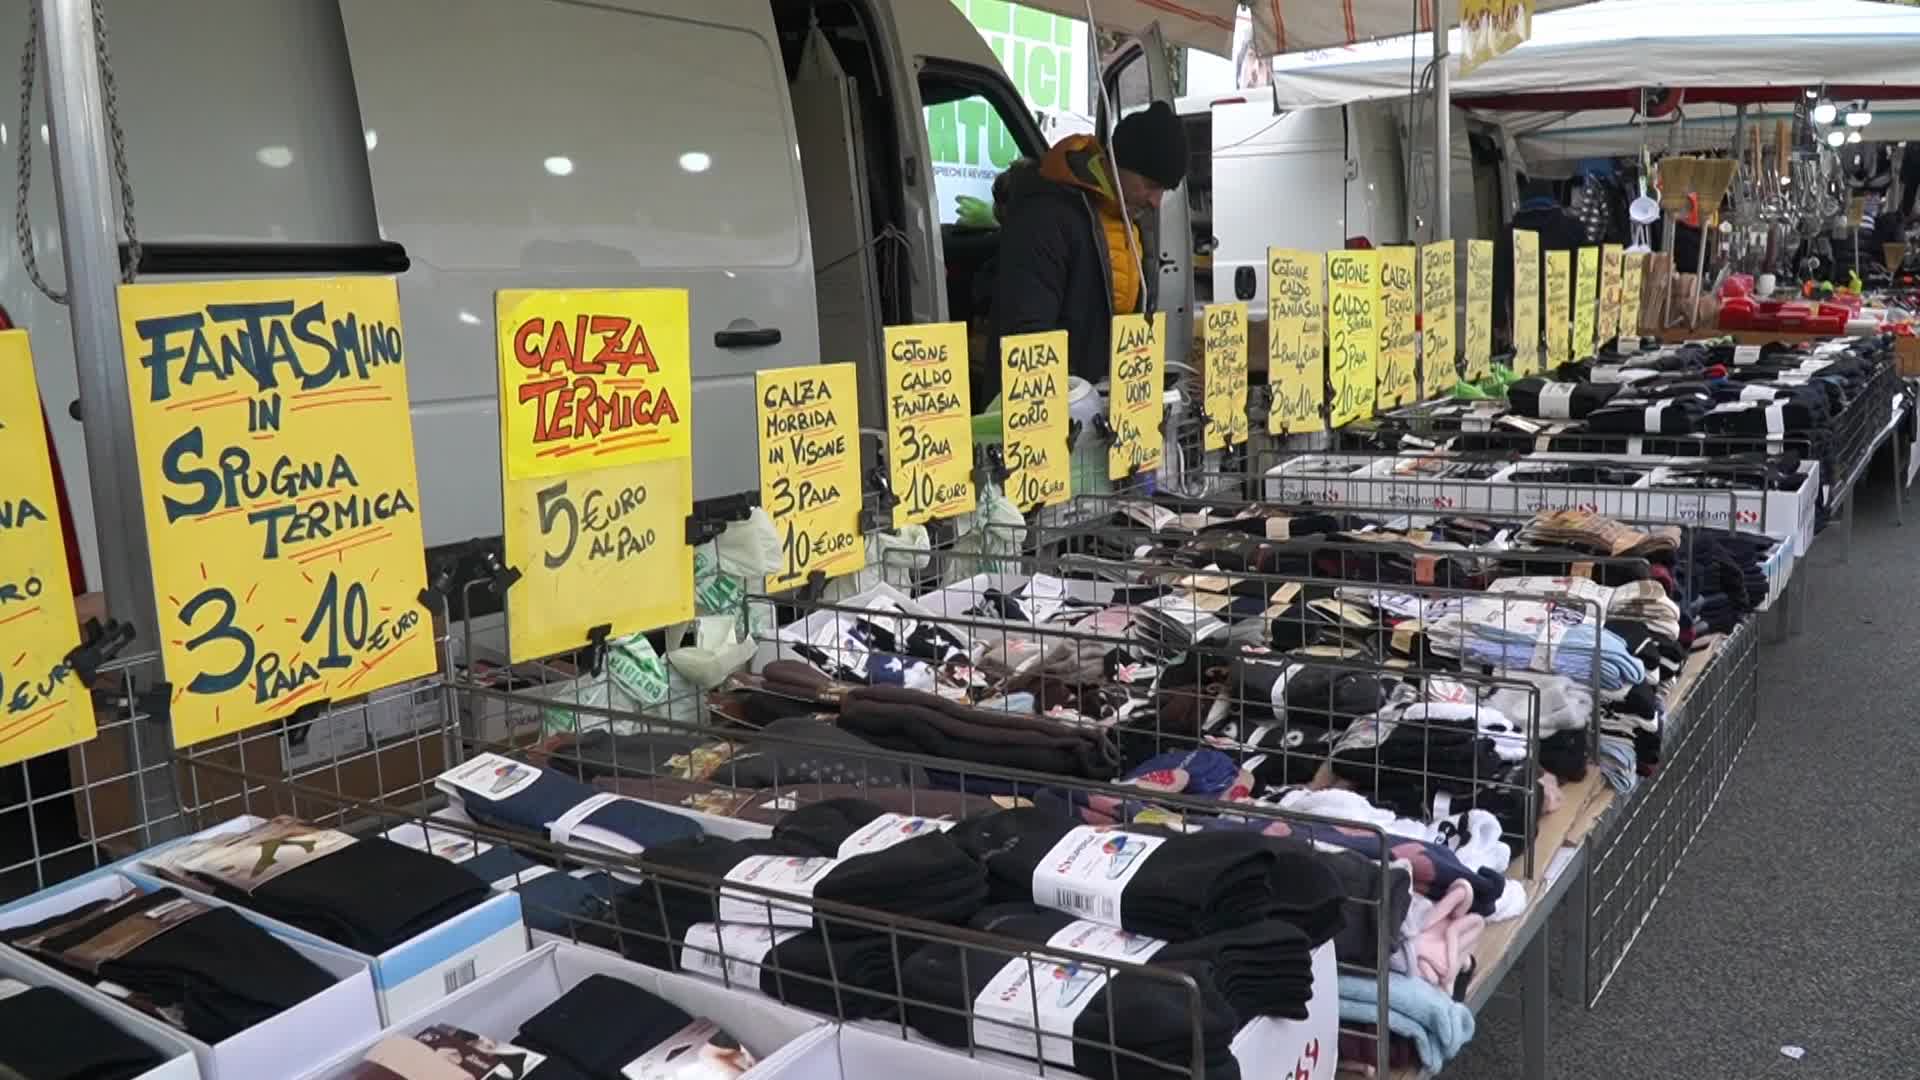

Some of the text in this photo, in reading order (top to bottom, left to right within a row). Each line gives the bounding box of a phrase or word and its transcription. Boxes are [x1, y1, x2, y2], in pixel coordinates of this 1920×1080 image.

[1271, 258, 1309, 281] COTONE
[1330, 257, 1371, 285] COTONE
[1380, 263, 1412, 291] CALZA
[1279, 280, 1311, 297] CALDO
[1332, 293, 1371, 319] CALDO
[136, 300, 402, 401] FANTASMINO
[513, 314, 659, 376] CALZA
[892, 339, 948, 362] COTONE
[1116, 325, 1156, 354] LANA
[1335, 330, 1348, 372] 3
[1007, 345, 1059, 374] CALZA
[1117, 357, 1153, 381] CORTO
[764, 380, 832, 408] CALZA
[901, 369, 952, 390] CALDO
[1008, 375, 1056, 401] LANA
[1126, 383, 1151, 403] UOMO
[518, 376, 679, 443] TERMICA
[892, 393, 961, 418] FANTASIA
[1336, 374, 1353, 417] 10
[247, 393, 281, 432] IN
[766, 411, 837, 438] MORBIDA
[1008, 401, 1049, 430] CORTO
[768, 436, 846, 465] IN VISONE
[899, 425, 952, 467] 3 PAIA
[1007, 441, 1021, 471] 3
[161, 427, 358, 524] SPUGNA
[772, 478, 840, 518] 3 PAIA
[904, 468, 934, 515] 10
[1017, 474, 1039, 508] 10
[248, 488, 415, 559] TERMICA
[536, 480, 578, 569] 5
[588, 528, 656, 562] AL PAIO
[778, 520, 811, 582] 10
[178, 587, 255, 694] 3
[255, 653, 321, 704] PAIA
[301, 572, 369, 669] 10
